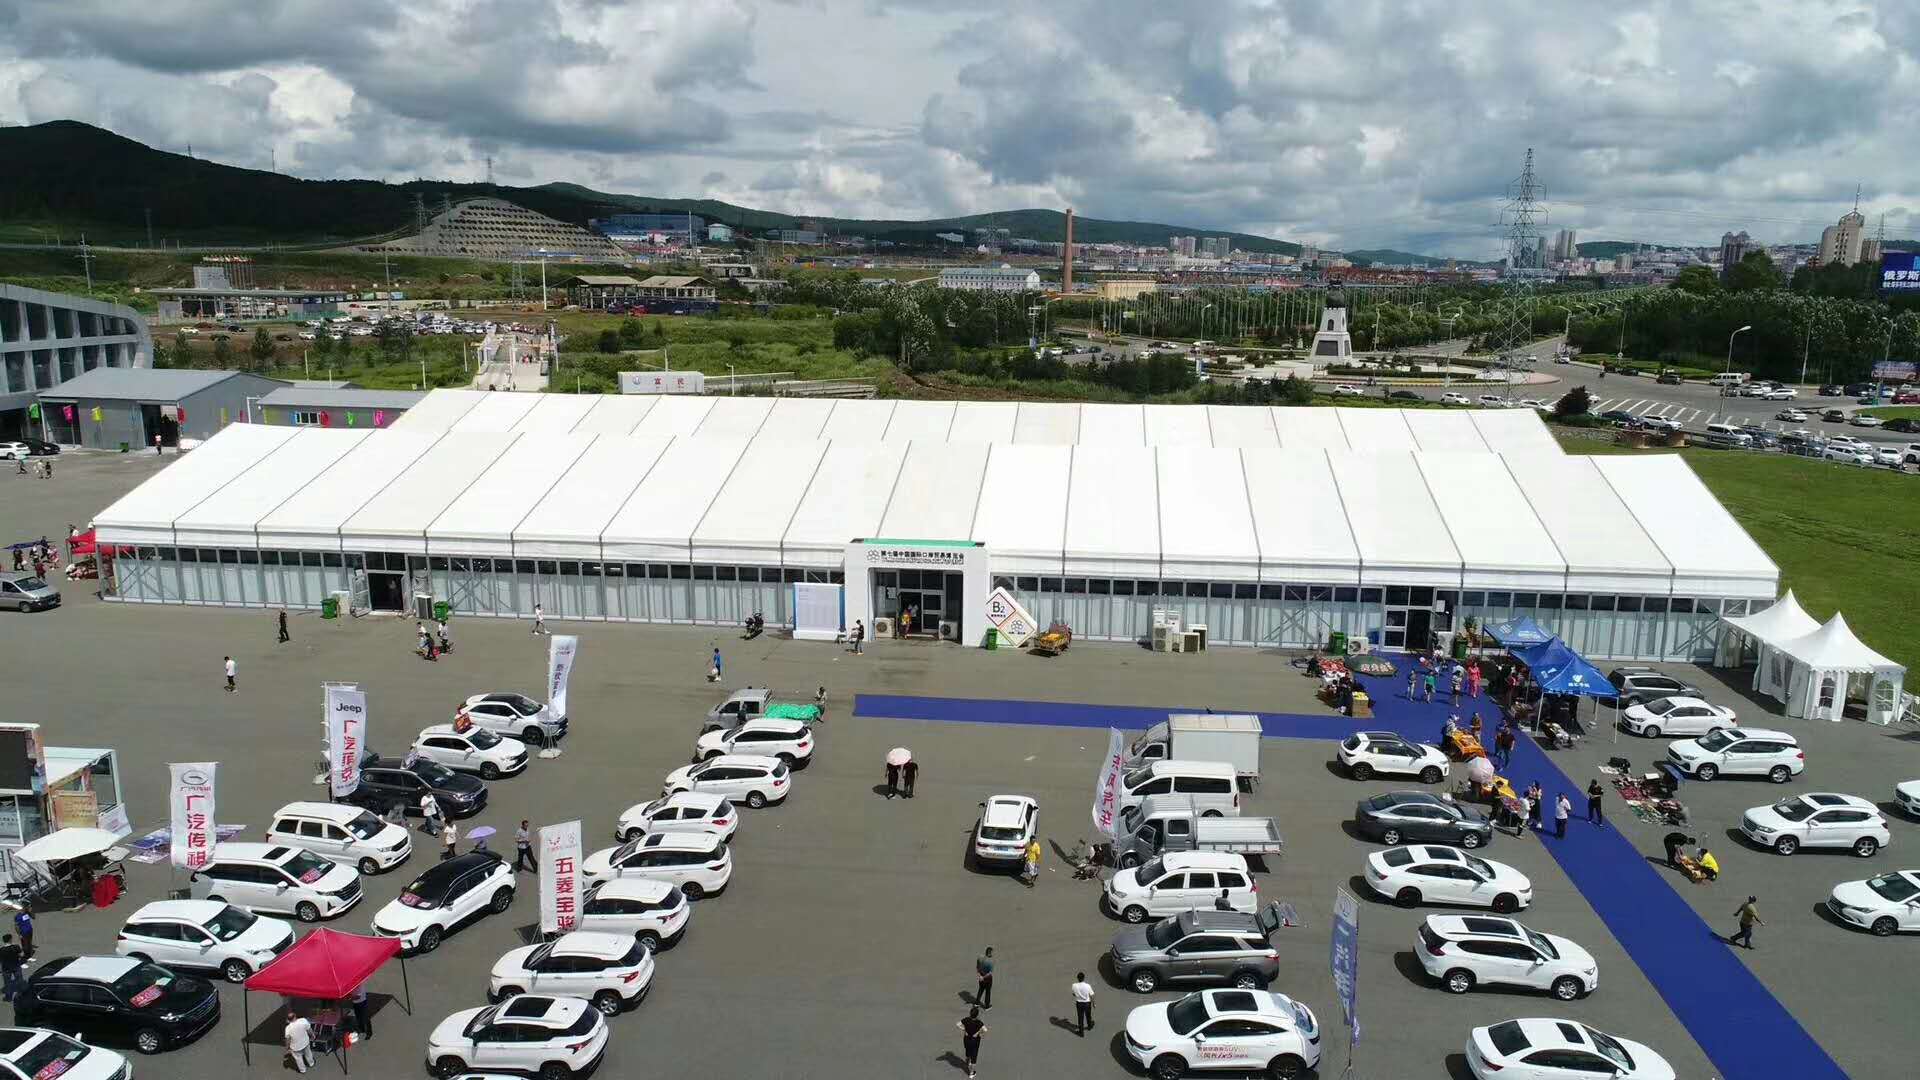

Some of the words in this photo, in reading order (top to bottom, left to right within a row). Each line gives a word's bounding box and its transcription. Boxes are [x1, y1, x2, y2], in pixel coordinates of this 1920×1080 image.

[336, 703, 362, 713] Jeep
[555, 857, 576, 932] 五菱宝骏
